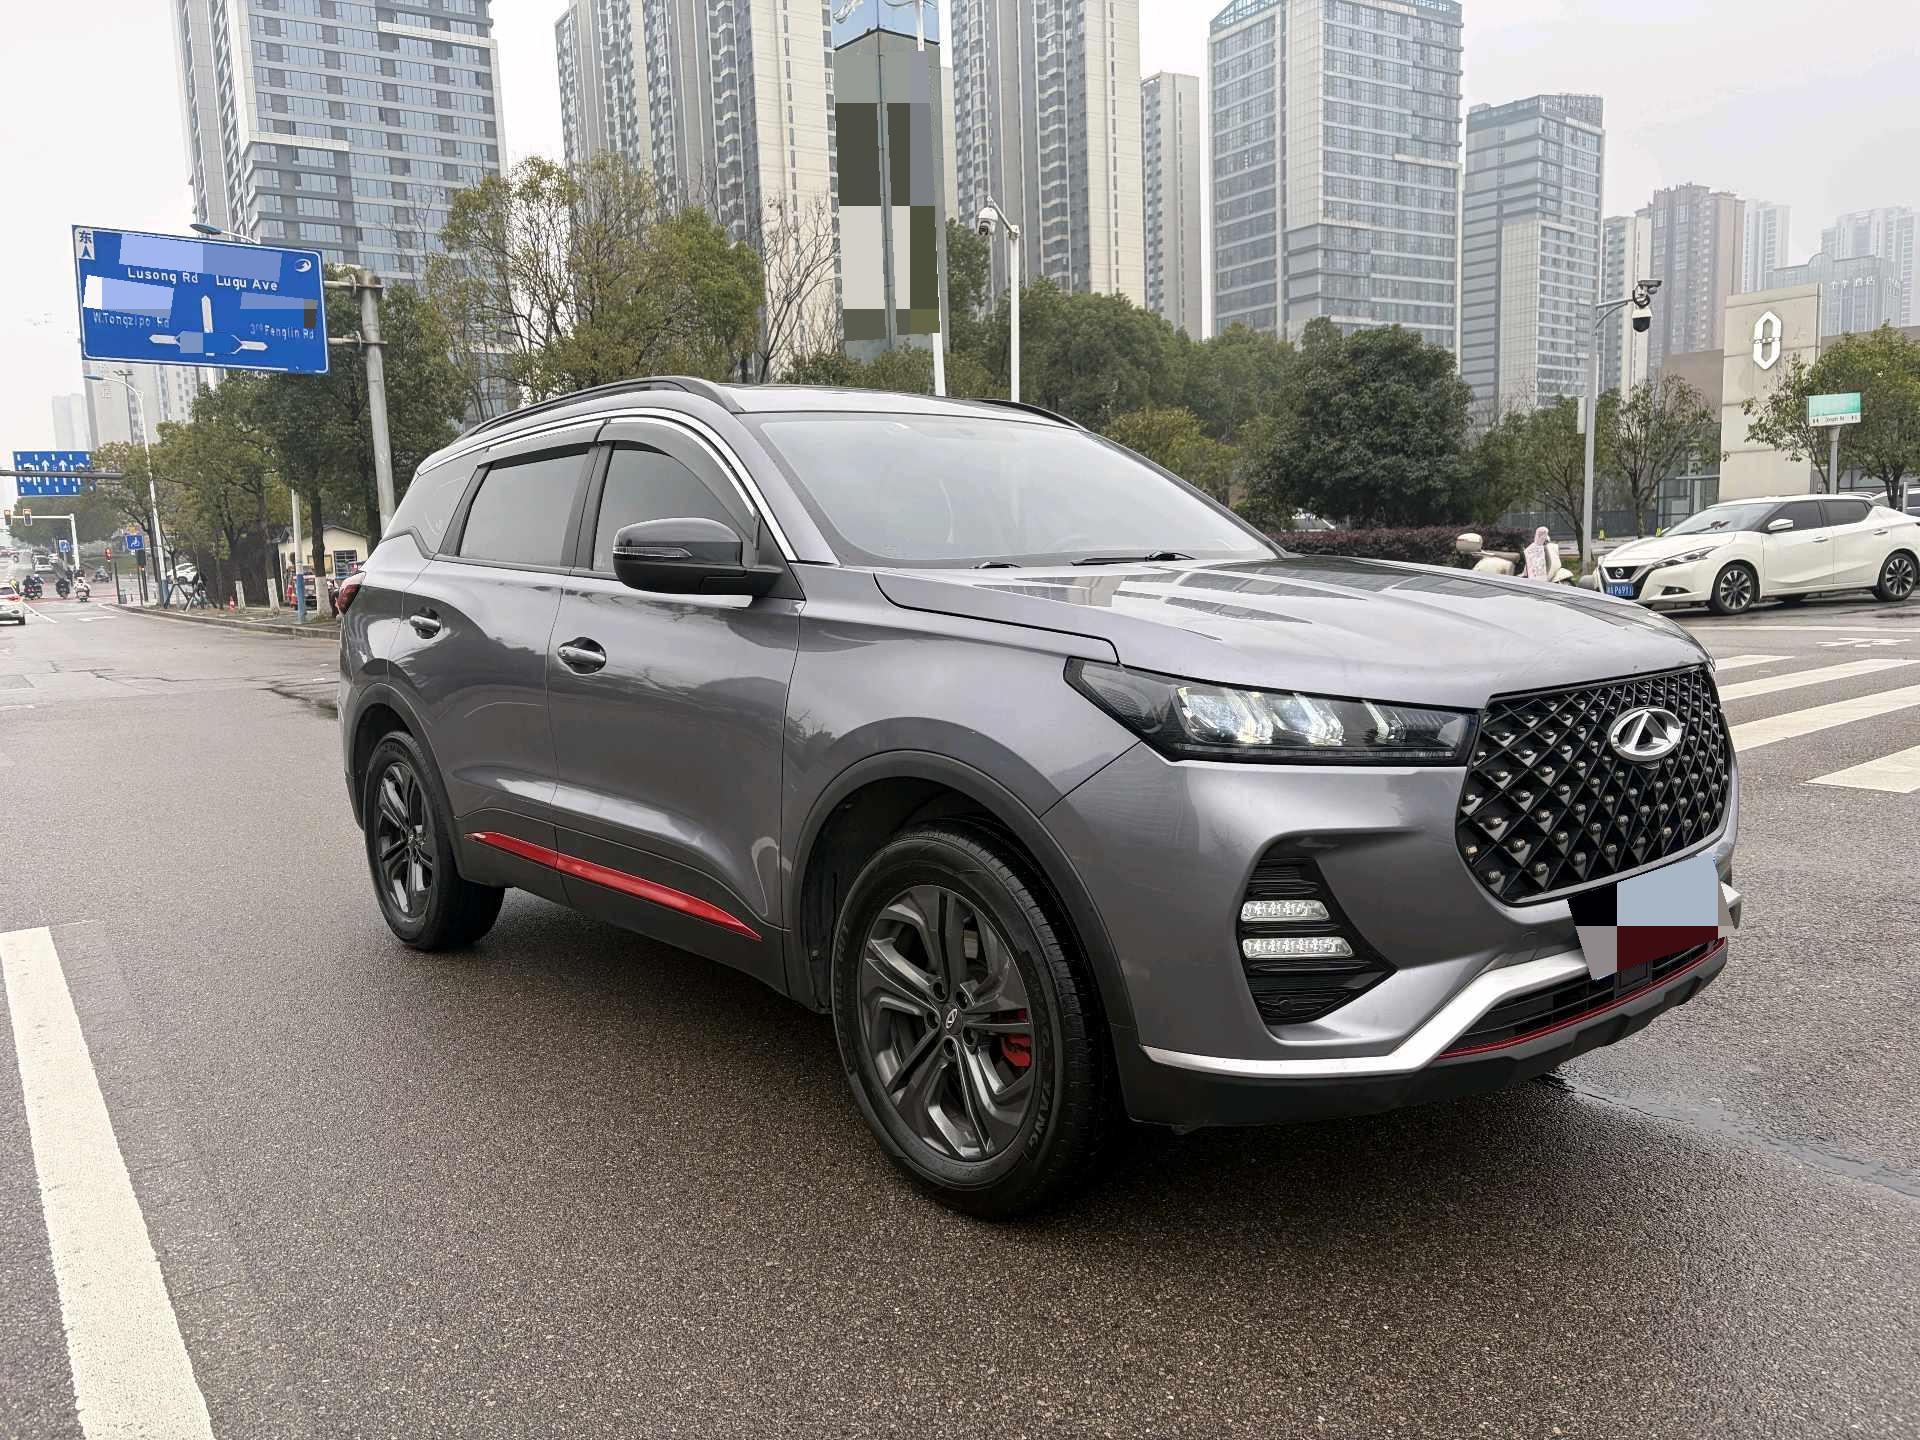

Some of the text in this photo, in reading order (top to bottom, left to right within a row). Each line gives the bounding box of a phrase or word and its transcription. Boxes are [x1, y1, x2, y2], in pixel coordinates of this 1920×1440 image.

[79, 230, 92, 243] 东
[128, 267, 199, 284] Lusong Rd
[216, 275, 278, 291] Lugu Ave
[303, 328, 314, 339] Rd
